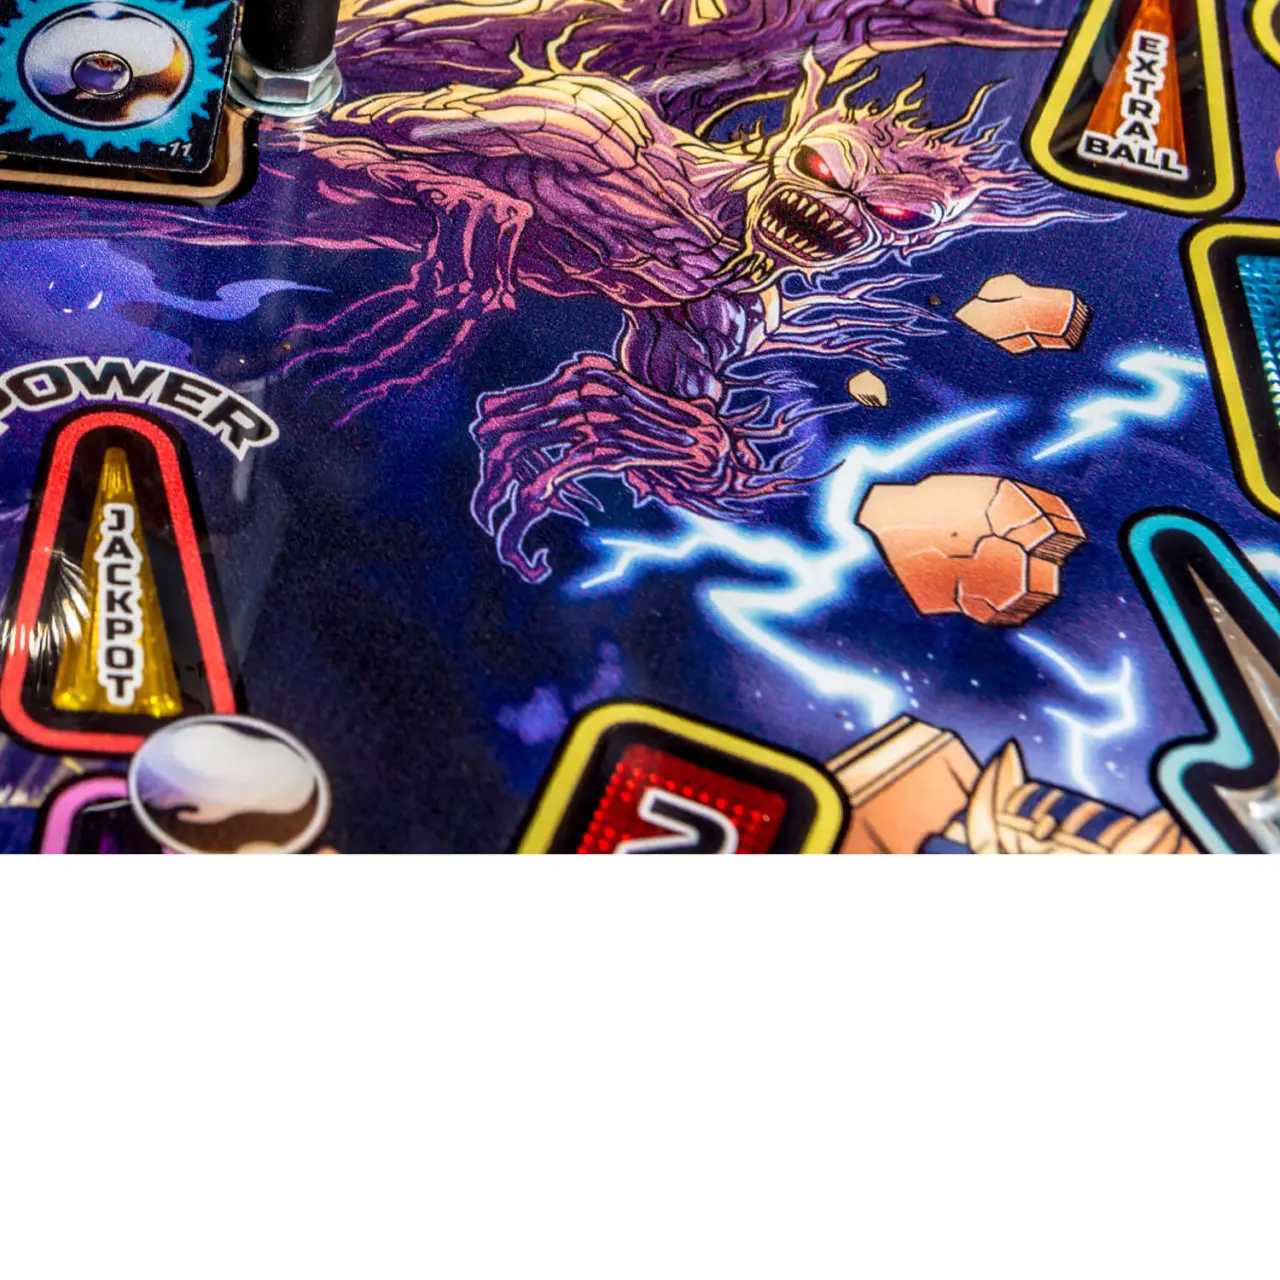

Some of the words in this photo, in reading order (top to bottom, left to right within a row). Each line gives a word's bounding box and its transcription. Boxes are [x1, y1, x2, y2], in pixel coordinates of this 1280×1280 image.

[1121, 33, 1164, 141] EXTRA
[158, 141, 192, 157] -11
[1082, 133, 1184, 176] BALL
[100, 506, 138, 701] JACKPOT
